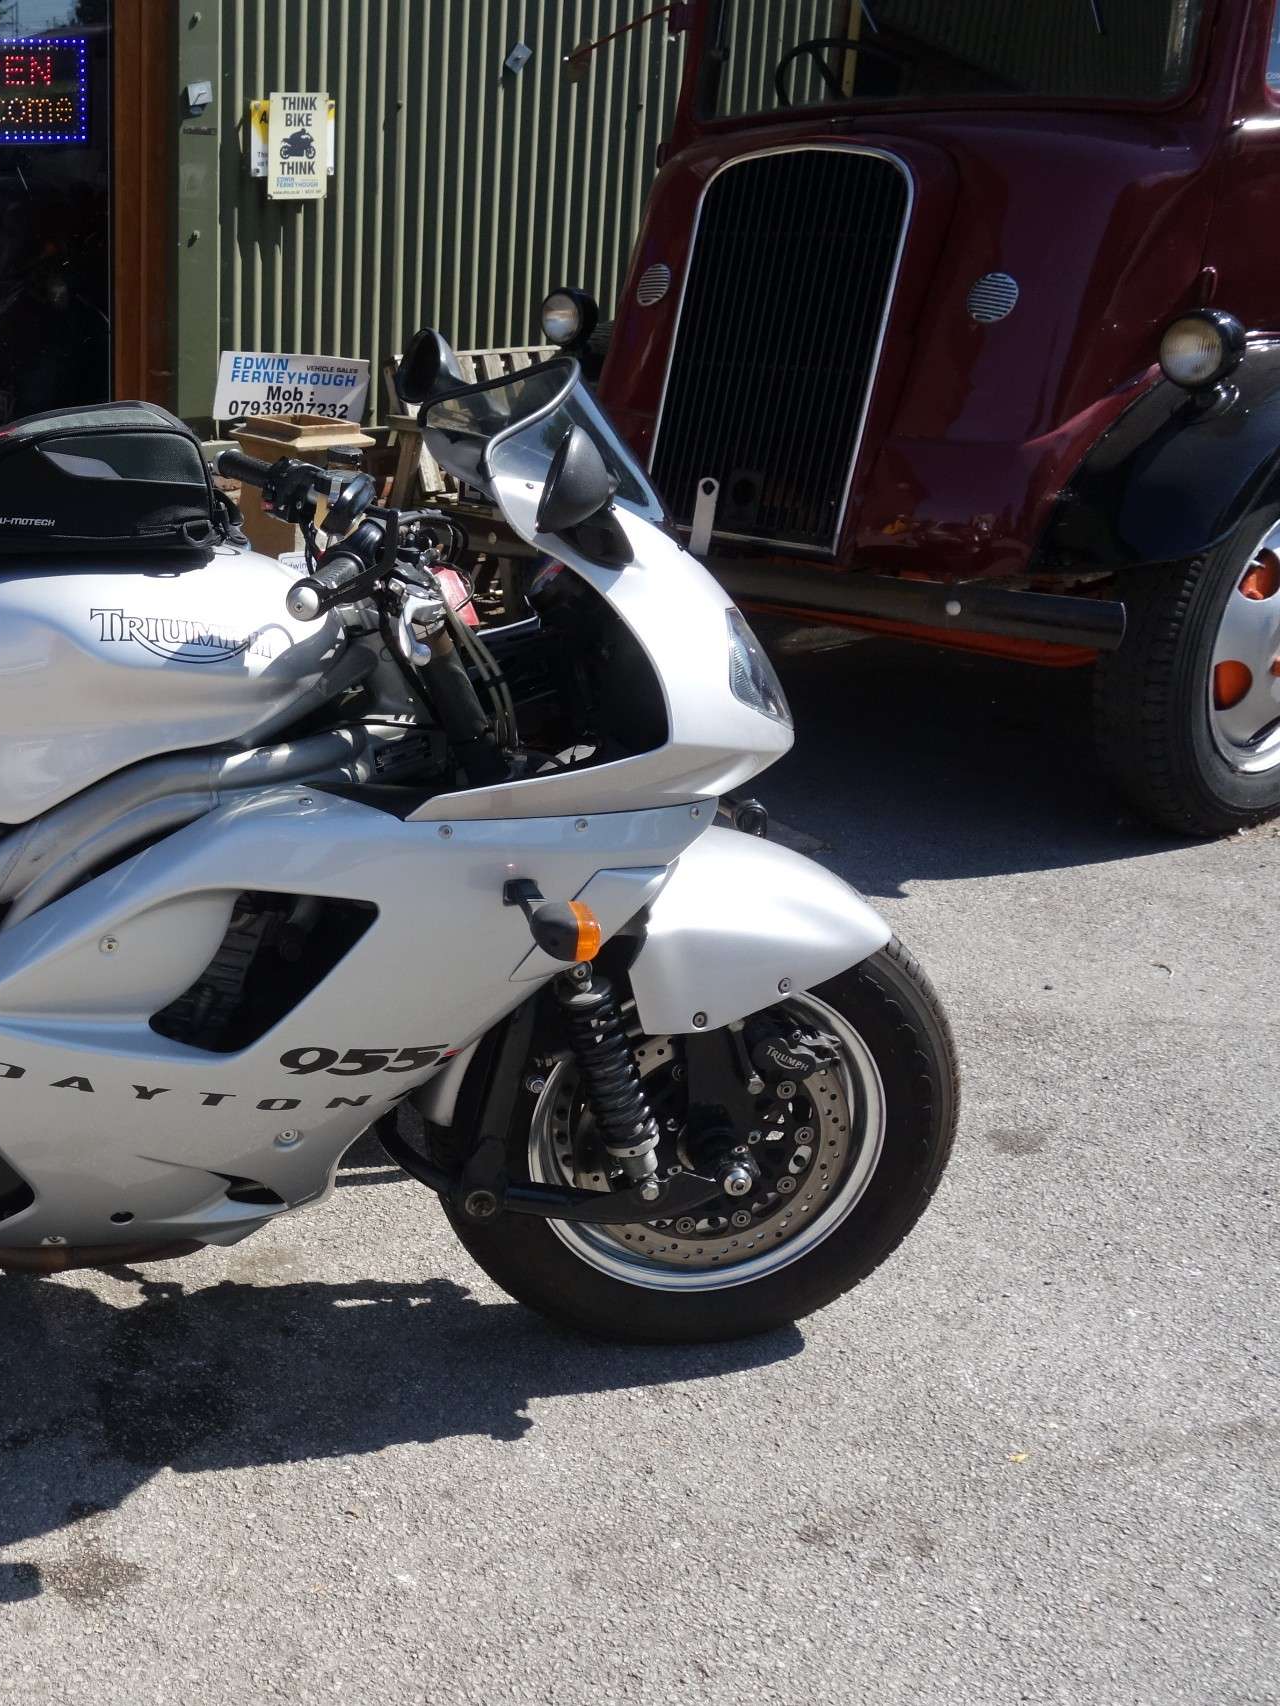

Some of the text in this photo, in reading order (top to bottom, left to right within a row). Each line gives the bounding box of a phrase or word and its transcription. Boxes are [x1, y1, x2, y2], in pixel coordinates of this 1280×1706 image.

[282, 97, 317, 111] THINK
[285, 113, 312, 127] BIKE
[280, 161, 315, 175] THINK
[233, 357, 289, 371] EDWIN
[307, 365, 334, 373] VEHICLE
[231, 370, 357, 387] FERNEYHOUGH
[266, 386, 304, 402] Mob
[228, 400, 349, 419] 07939207232
[90, 608, 272, 664] TRIUM
[766, 1045, 809, 1071] TRIUMPH
